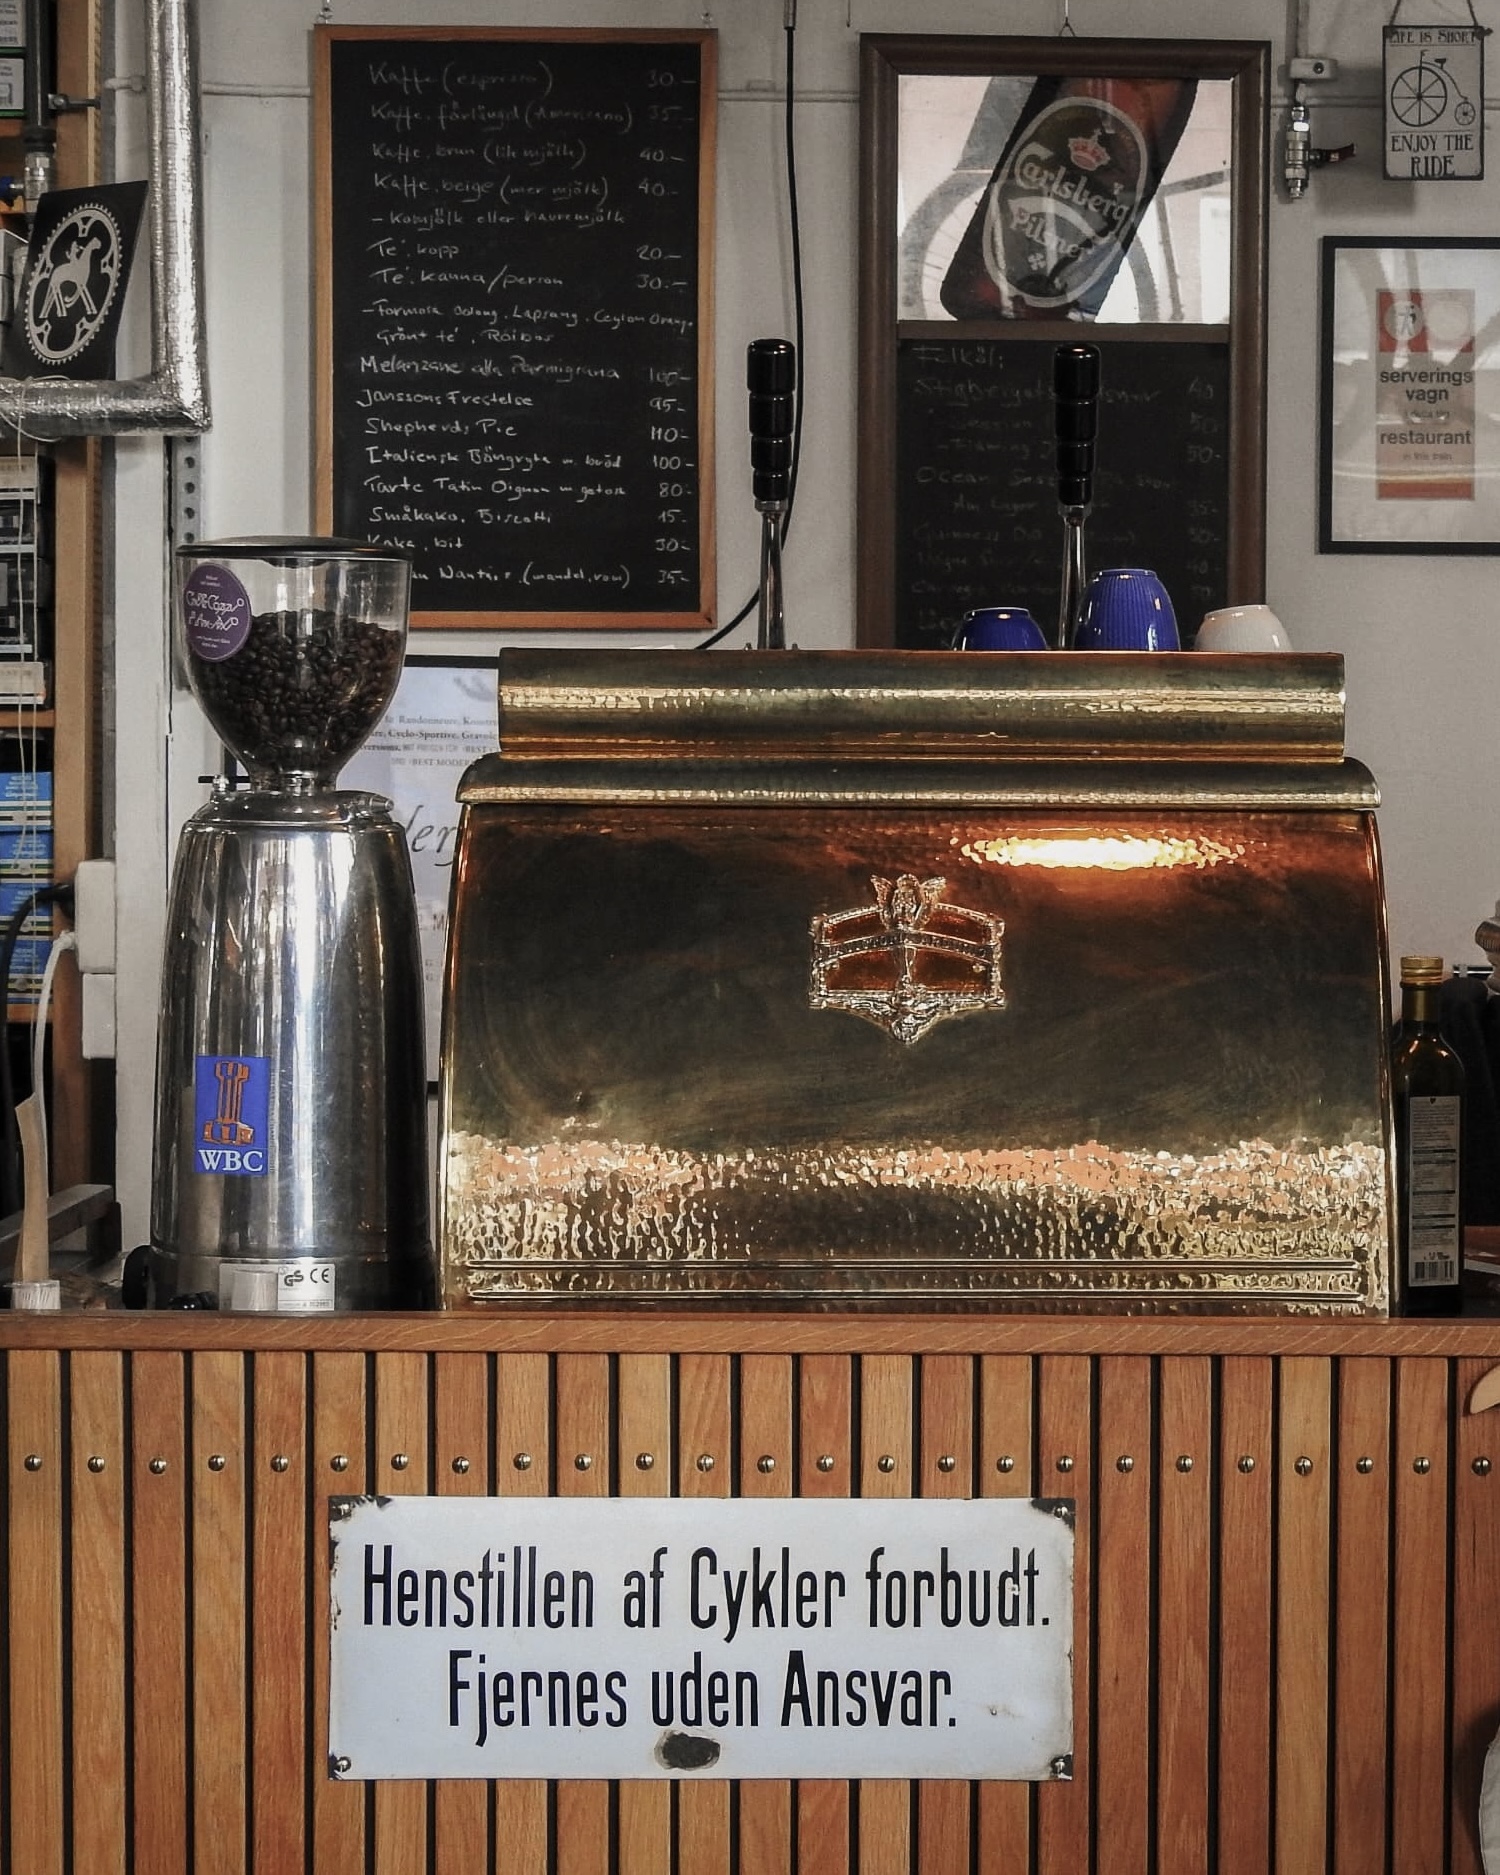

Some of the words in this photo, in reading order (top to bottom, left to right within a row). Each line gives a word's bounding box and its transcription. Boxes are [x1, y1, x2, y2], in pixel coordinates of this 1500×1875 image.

[1389, 30, 1415, 44] LIFE
[1420, 30, 1432, 44] IS
[1438, 29, 1476, 44] SHORT
[369, 61, 437, 94] Kaffe
[1391, 134, 1438, 153] ENJOY
[1444, 134, 1474, 151] THE
[1410, 155, 1455, 178] RIDE
[442, 179, 494, 203] beige
[1014, 142, 1130, 232] Carlsberg
[477, 211, 515, 223] eller
[416, 244, 460, 259] kopp
[360, 355, 463, 375] Melanzane
[471, 358, 503, 377] alla
[1380, 367, 1473, 386] serverings
[355, 388, 443, 407] Janssons
[448, 389, 534, 406] Frestelse
[1405, 388, 1449, 404] vagn
[475, 418, 518, 436] Pie
[1380, 430, 1471, 445] restaurant
[363, 475, 424, 494] Tarte
[433, 476, 482, 492] Tatin
[198, 1150, 263, 1171] WBC
[310, 1268, 330, 1284] CE
[364, 1544, 593, 1628] Henstillen
[623, 1547, 668, 1628] af
[690, 1547, 845, 1643] Cykler
[866, 1547, 1050, 1628] forbudt.
[449, 1650, 627, 1746] Fjernes
[652, 1652, 758, 1727] uden
[781, 1651, 956, 1727] Ansvar.
